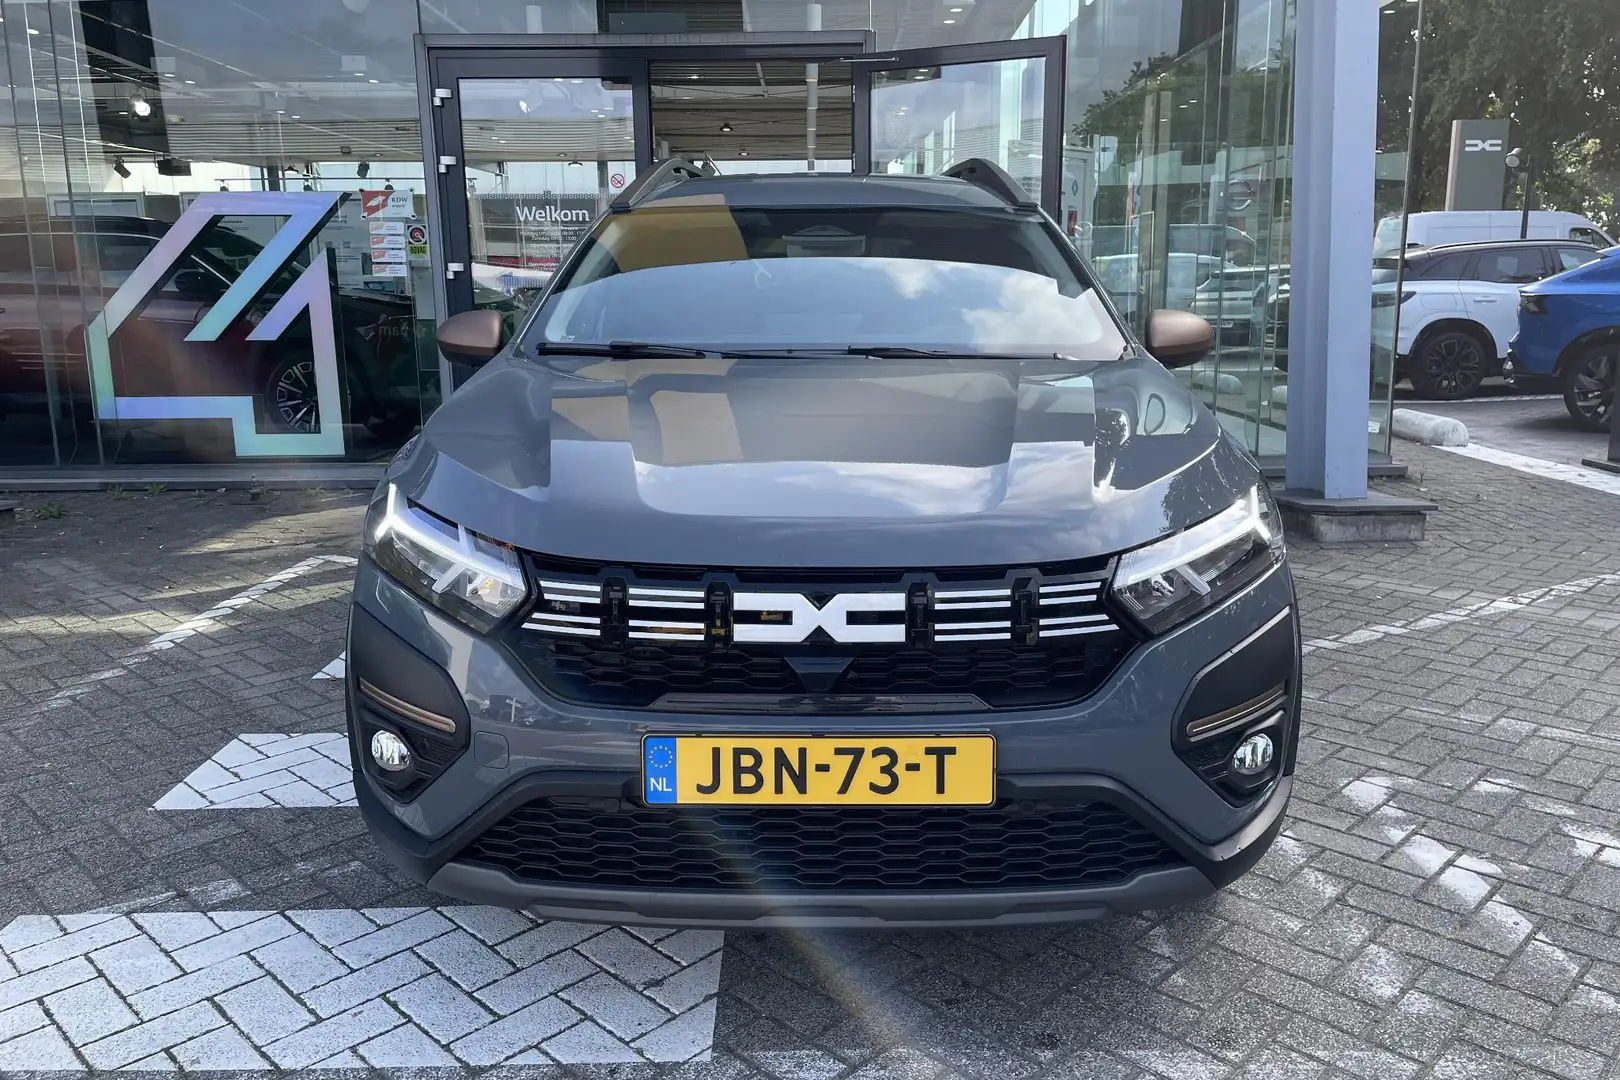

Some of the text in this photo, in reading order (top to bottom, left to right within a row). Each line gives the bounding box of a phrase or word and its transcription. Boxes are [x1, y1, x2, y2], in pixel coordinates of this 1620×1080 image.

[516, 205, 590, 222] Welkom
[695, 746, 957, 795] JBN-73-T
[650, 777, 672, 791] NL
